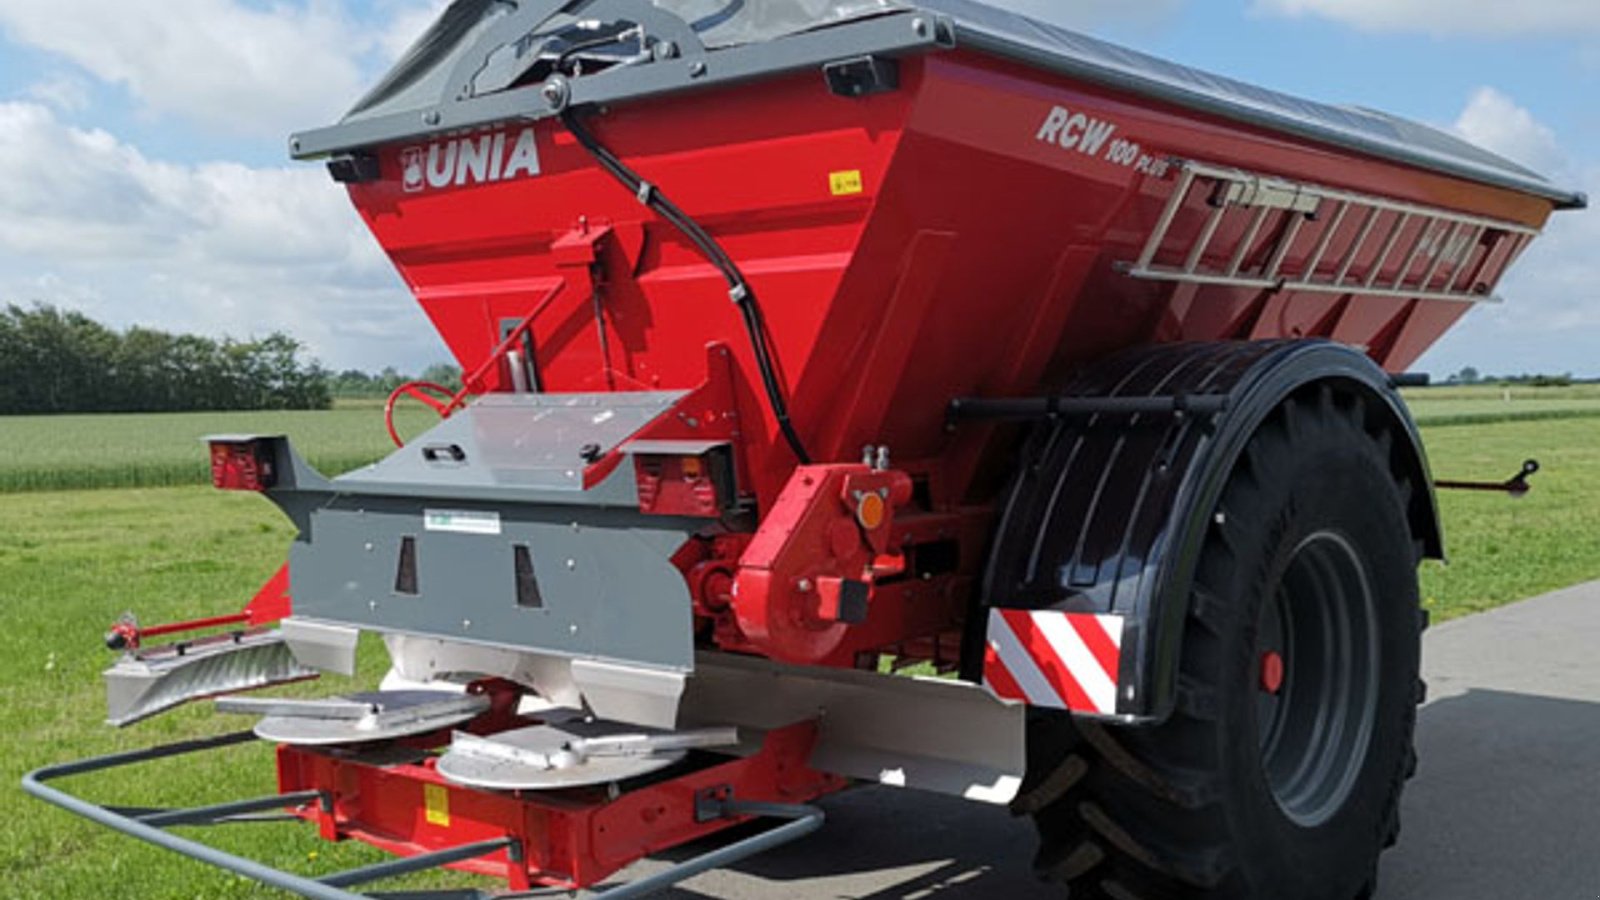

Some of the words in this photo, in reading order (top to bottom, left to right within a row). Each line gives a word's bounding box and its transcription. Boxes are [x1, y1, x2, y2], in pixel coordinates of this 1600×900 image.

[426, 127, 541, 188] UNIA
[1036, 105, 1116, 156] RCW
[1105, 138, 1139, 166] 100
[1134, 154, 1169, 177] PLUS
